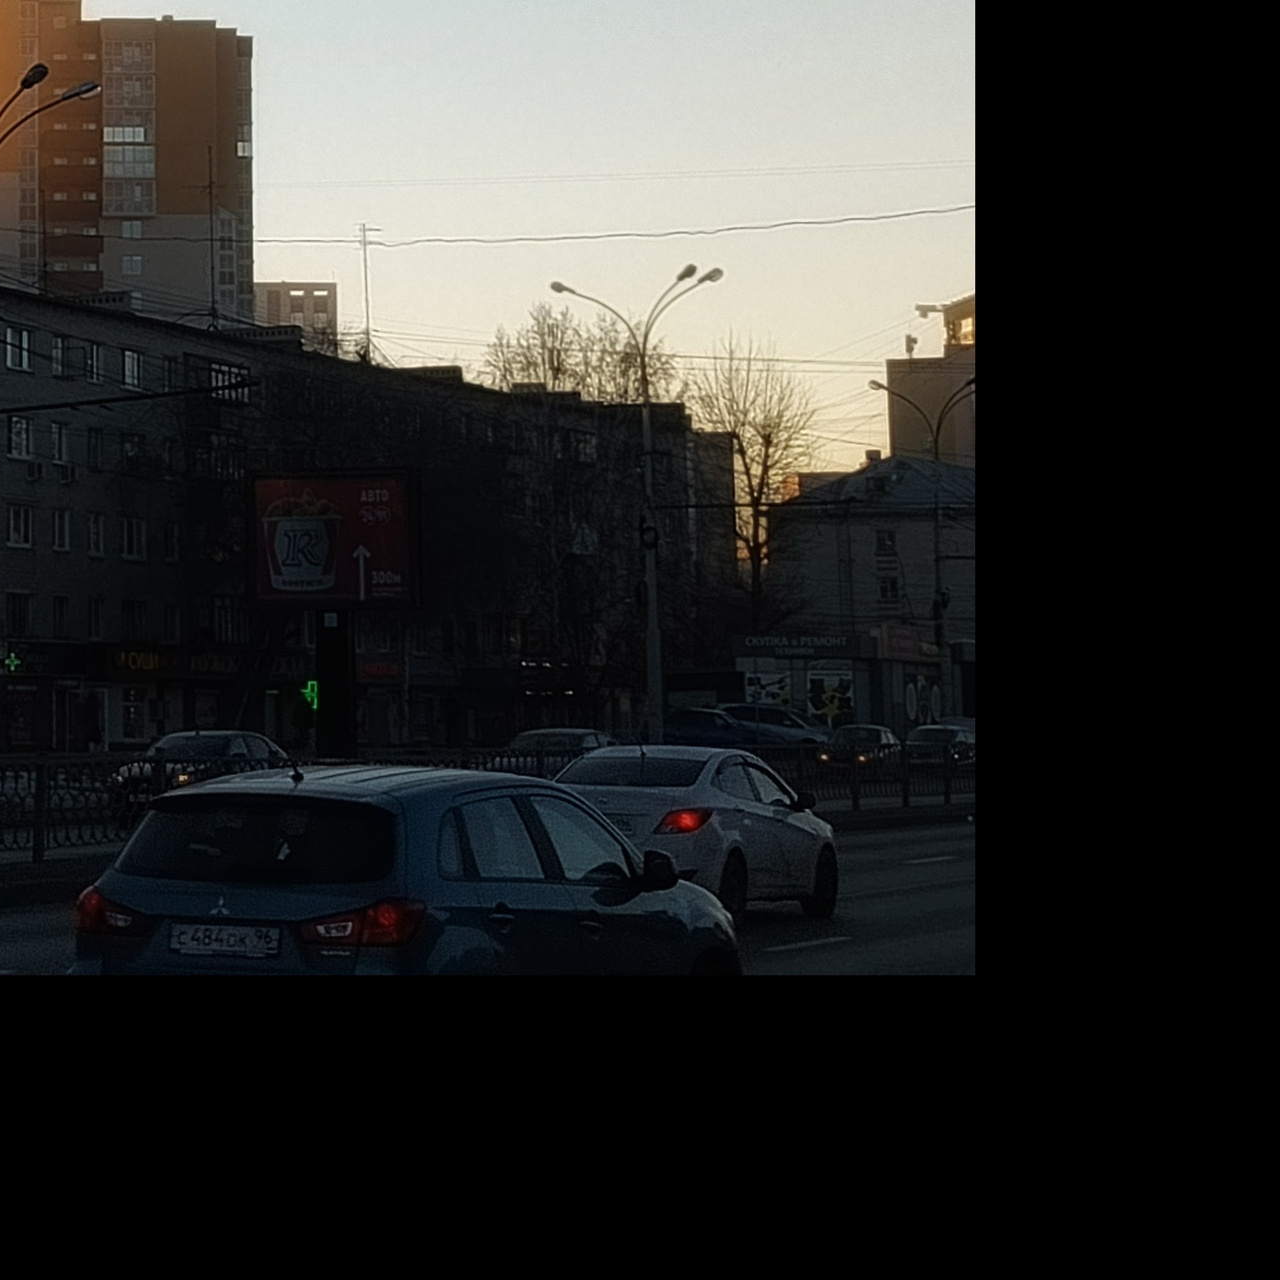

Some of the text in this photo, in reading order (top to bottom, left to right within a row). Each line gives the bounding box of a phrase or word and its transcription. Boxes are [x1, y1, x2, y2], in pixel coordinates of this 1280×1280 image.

[360, 488, 390, 503] АВТО
[281, 528, 323, 568] R
[744, 635, 789, 647] СКУПКА
[800, 635, 848, 647] РЕМОНТ
